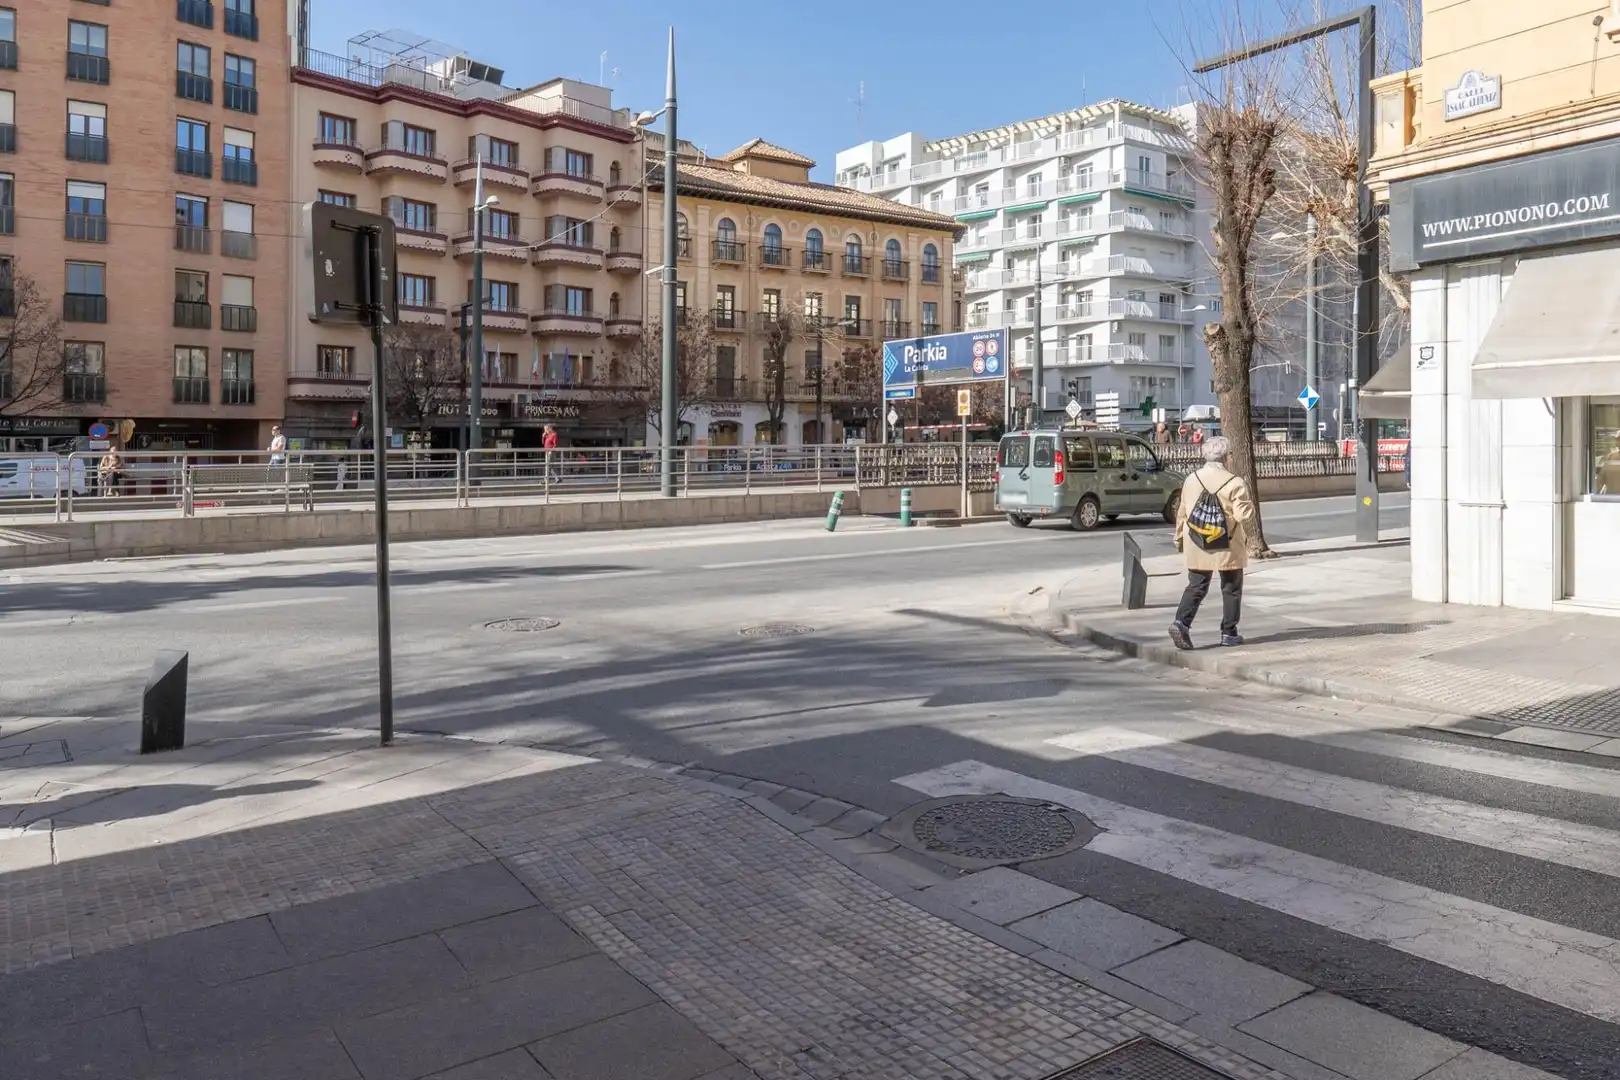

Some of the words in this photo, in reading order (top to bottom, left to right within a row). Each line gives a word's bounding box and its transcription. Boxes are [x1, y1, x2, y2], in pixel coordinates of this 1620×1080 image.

[1447, 100, 1465, 113] ISAAC
[1422, 193, 1610, 237] WWW.PIONONO.COM
[904, 342, 947, 364] Parkia
